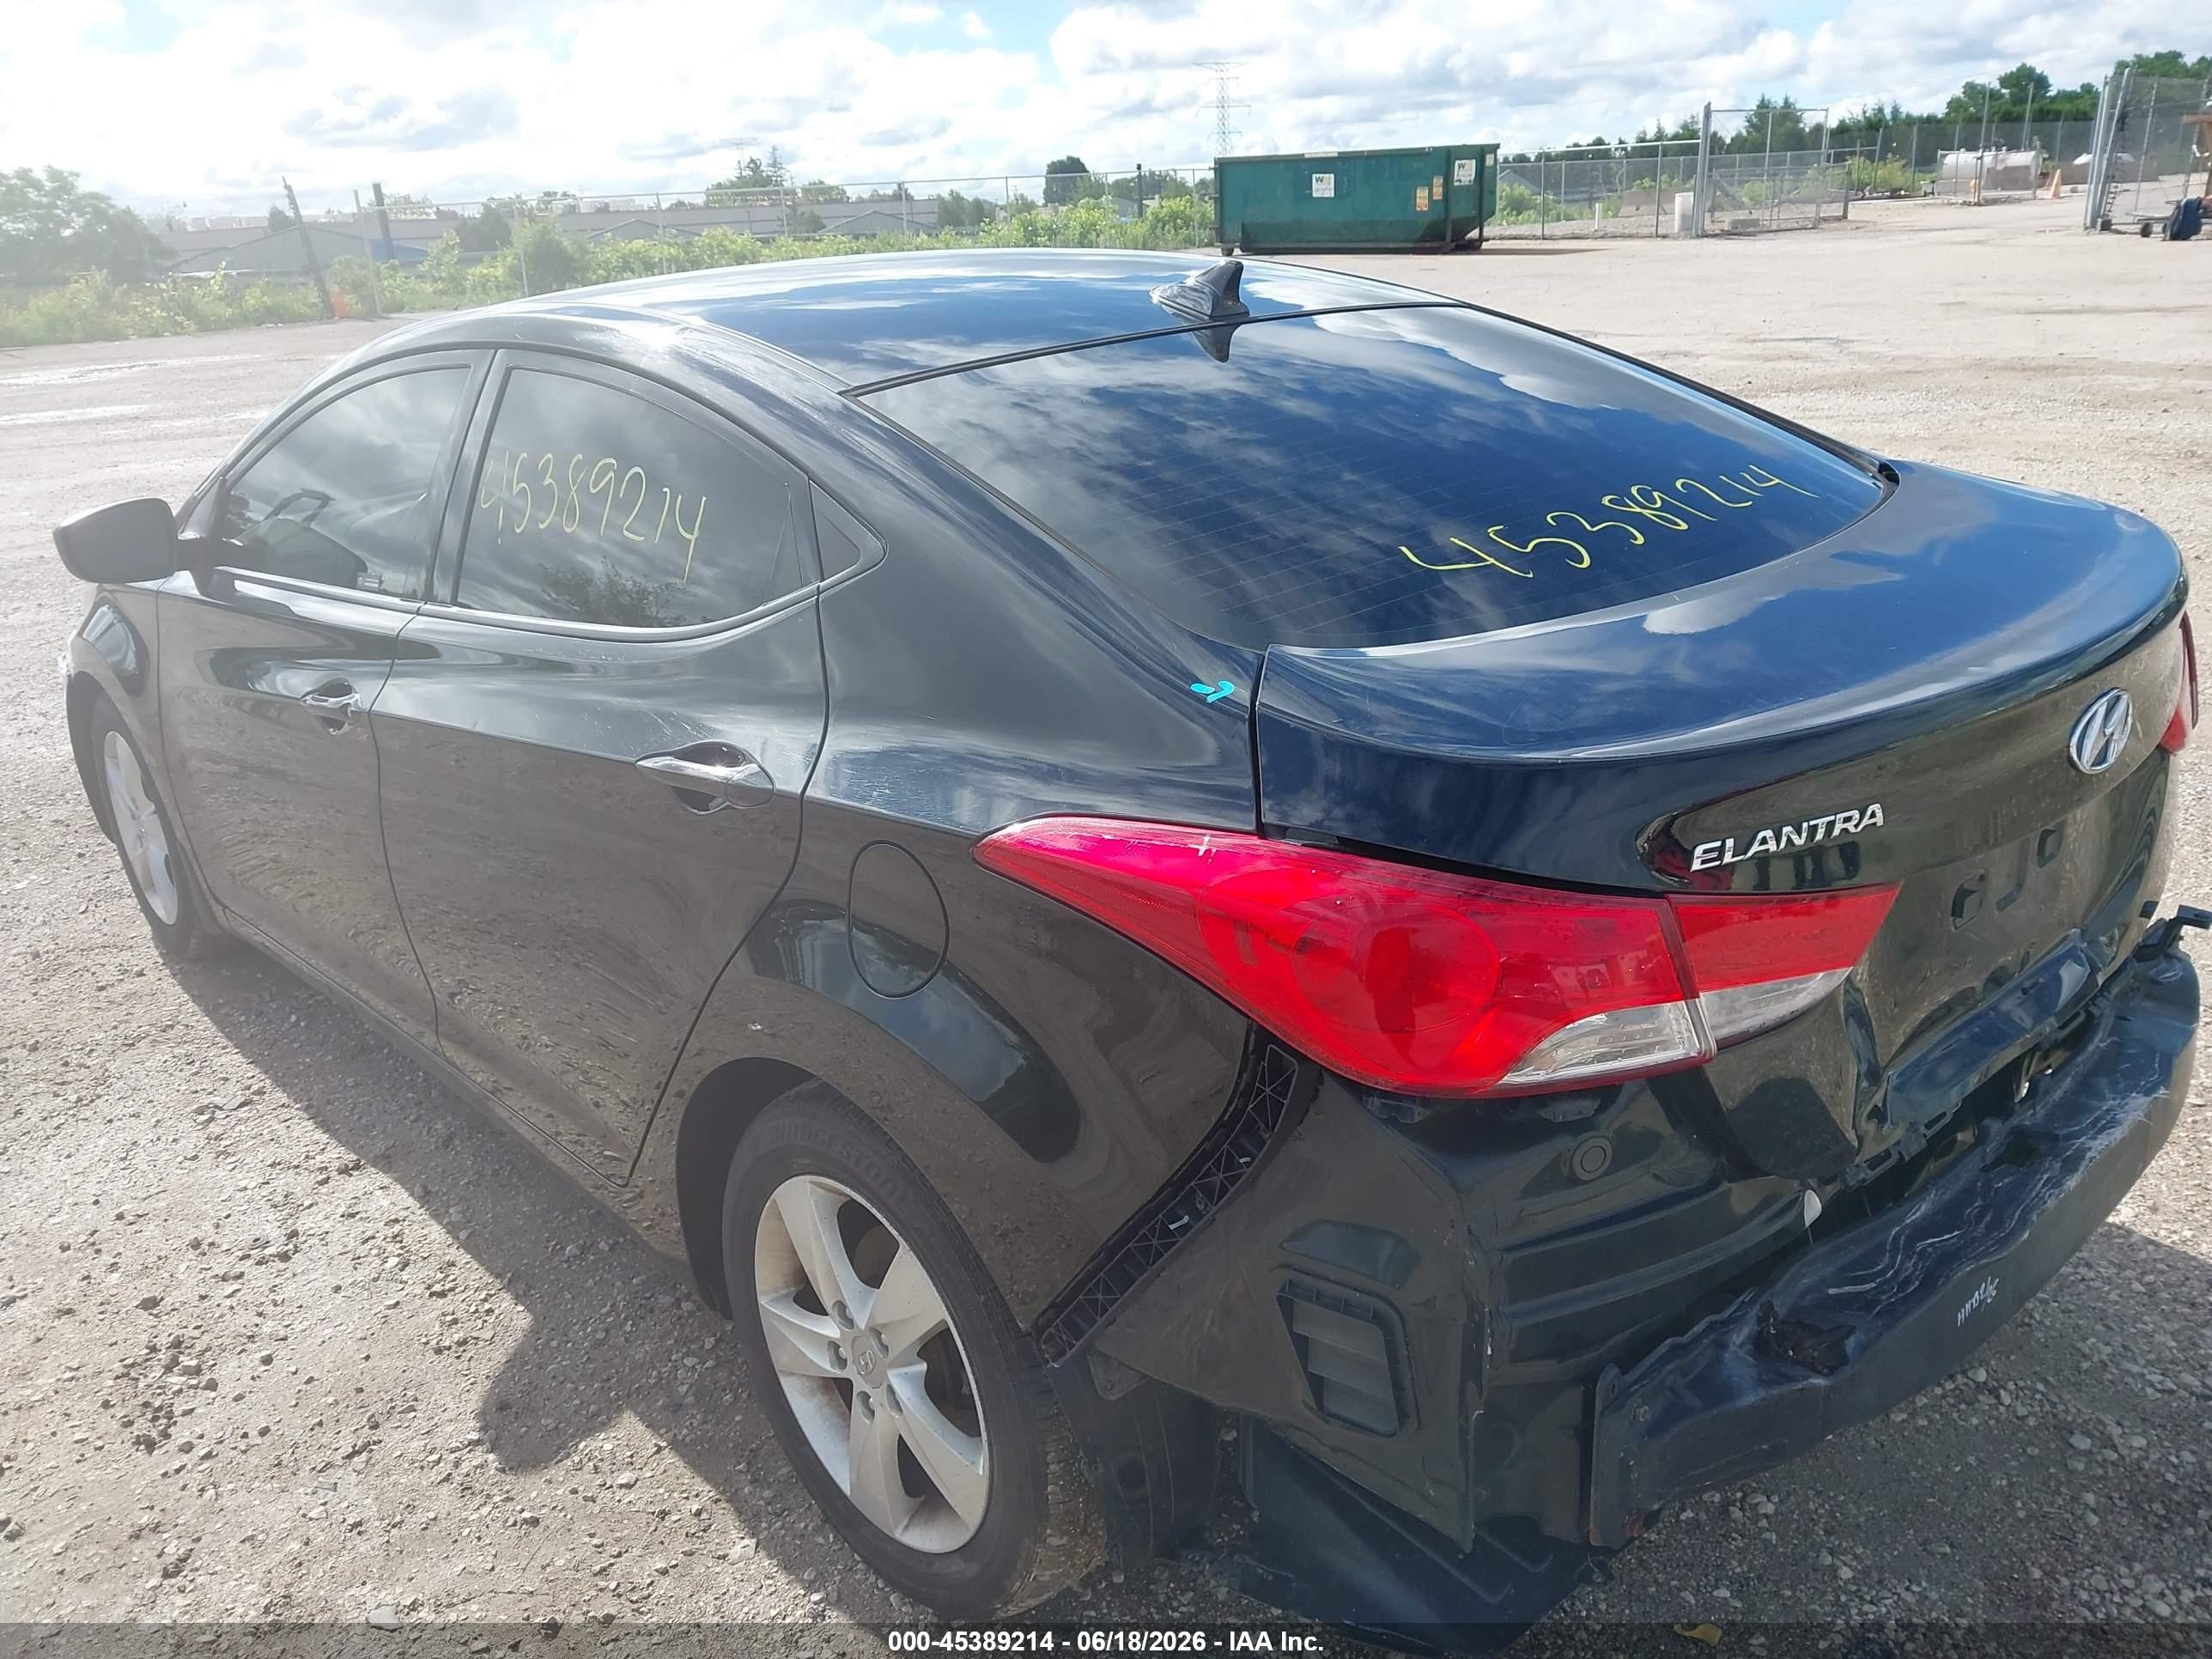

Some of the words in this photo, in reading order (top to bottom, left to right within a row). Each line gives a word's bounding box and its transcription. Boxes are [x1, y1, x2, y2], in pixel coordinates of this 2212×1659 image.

[480, 451, 707, 585] 45389214
[1397, 465, 1820, 579] 45389214
[1689, 802, 1885, 872] ELANTRA
